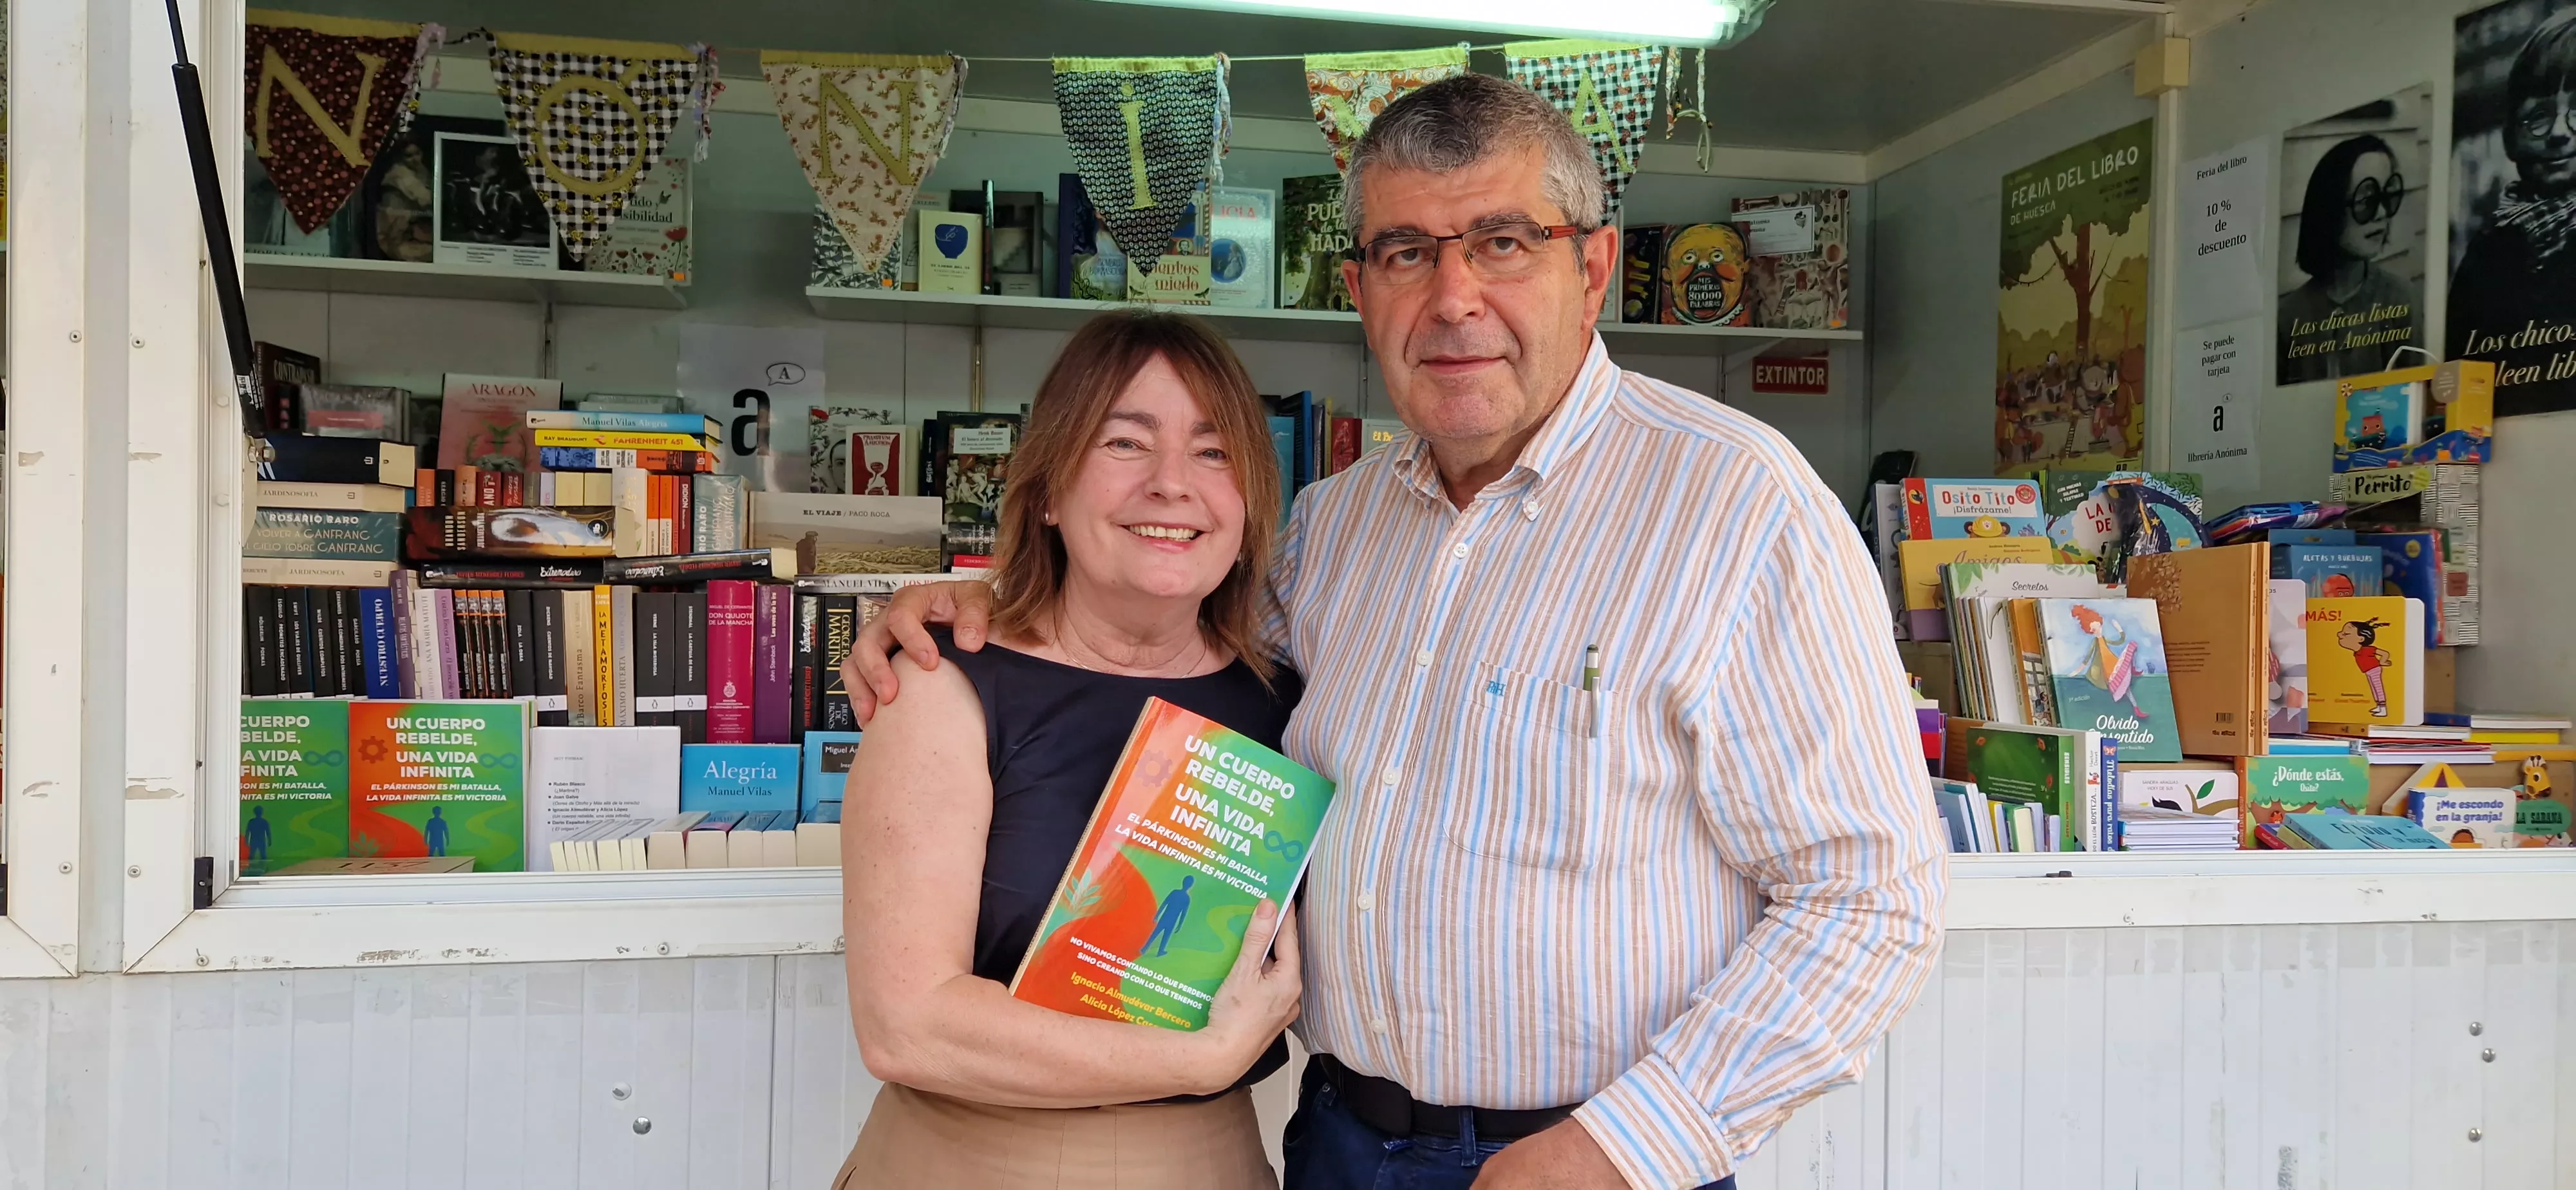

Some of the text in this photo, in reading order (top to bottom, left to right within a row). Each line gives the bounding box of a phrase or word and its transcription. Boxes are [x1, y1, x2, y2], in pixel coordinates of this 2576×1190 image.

[817, 74, 918, 185] N
[2012, 176, 2050, 209] FERIA
[2058, 166, 2085, 191] DEL
[2092, 146, 2139, 179] LIBRO
[2197, 156, 2247, 180] Feria del libro
[2011, 200, 2056, 225] DE HUESCA
[2206, 199, 2231, 217] 10 %
[2215, 219, 2227, 232] de
[2198, 234, 2246, 256] descuento
[1689, 300, 1720, 308] PALABRAS
[2291, 302, 2409, 336] Las chicas listas
[2203, 335, 2235, 351] Se puede
[2288, 325, 2411, 359] leen en Anónima
[2463, 330, 2505, 355] Los
[2202, 350, 2236, 366] pagar con
[778, 367, 790, 381] A
[1756, 366, 1825, 386] EXTINTOR
[2208, 366, 2230, 377] tarjeta
[2495, 350, 2576, 388] leen lib
[582, 417, 613, 426] Manuel
[731, 388, 770, 457] a
[2213, 406, 2224, 431] a
[2188, 448, 2247, 462] librería Anónima
[2354, 474, 2411, 495] Perrito
[1942, 491, 2015, 505] Osito Tito
[269, 514, 359, 524] ROSARIO RARO
[1953, 505, 2012, 515] ¡Disfrázame!
[304, 529, 371, 540] CANFRANC
[317, 542, 384, 554] CANFRANC
[2337, 554, 2373, 562] BURBUJAS
[2011, 581, 2049, 591] Secretos
[374, 598, 388, 686] NUESTRO CUERPO
[829, 615, 840, 665] MARTIN
[599, 621, 608, 726] METAMORFOSIS
[386, 718, 486, 730] UN CUERPO
[835, 710, 841, 720] DE
[2096, 715, 2139, 730] Olvido
[395, 733, 477, 746] REBELDE,
[396, 751, 478, 763] UNA VIDA
[825, 746, 848, 755] Miguel
[400, 766, 474, 778] INFINITA
[703, 760, 777, 785] Alegría
[1184, 735, 1295, 799] UN CUERPO
[2273, 766, 2344, 786] ¿Dónde estás,
[383, 782, 436, 791] PÁRKINSON
[1185, 759, 1275, 817] REBELDE,
[2106, 760, 2114, 800] Melodías
[708, 786, 772, 796] Manuel Vilas
[1175, 782, 1265, 840] UNA VIDA
[2104, 802, 2113, 822] para
[2437, 800, 2456, 811] ¡Me
[2451, 813, 2461, 821] la
[2463, 812, 2503, 823] granja!
[2516, 813, 2562, 824] LA SABANA
[1170, 805, 1251, 856] INFINITA
[1127, 813, 1269, 885] EL PÁRKINSON ES MI BATALLA,
[1115, 824, 1268, 899] LA VIDA INFINITA ES MI VICTORIA
[1070, 936, 1083, 947] NO
[1083, 942, 1117, 962] VIVAMOS
[1116, 957, 1153, 977] CONTANDO
[1153, 972, 1162, 981] LO
[1163, 976, 1179, 988] QUE
[1077, 952, 1203, 1010] SINO CREANDO CON LO QUE TENEMOS
[1070, 972, 1191, 1028] Ignacio Almudévar Bercero
[1080, 994, 1107, 1011] Alicia
[1108, 1004, 1135, 1023] López
